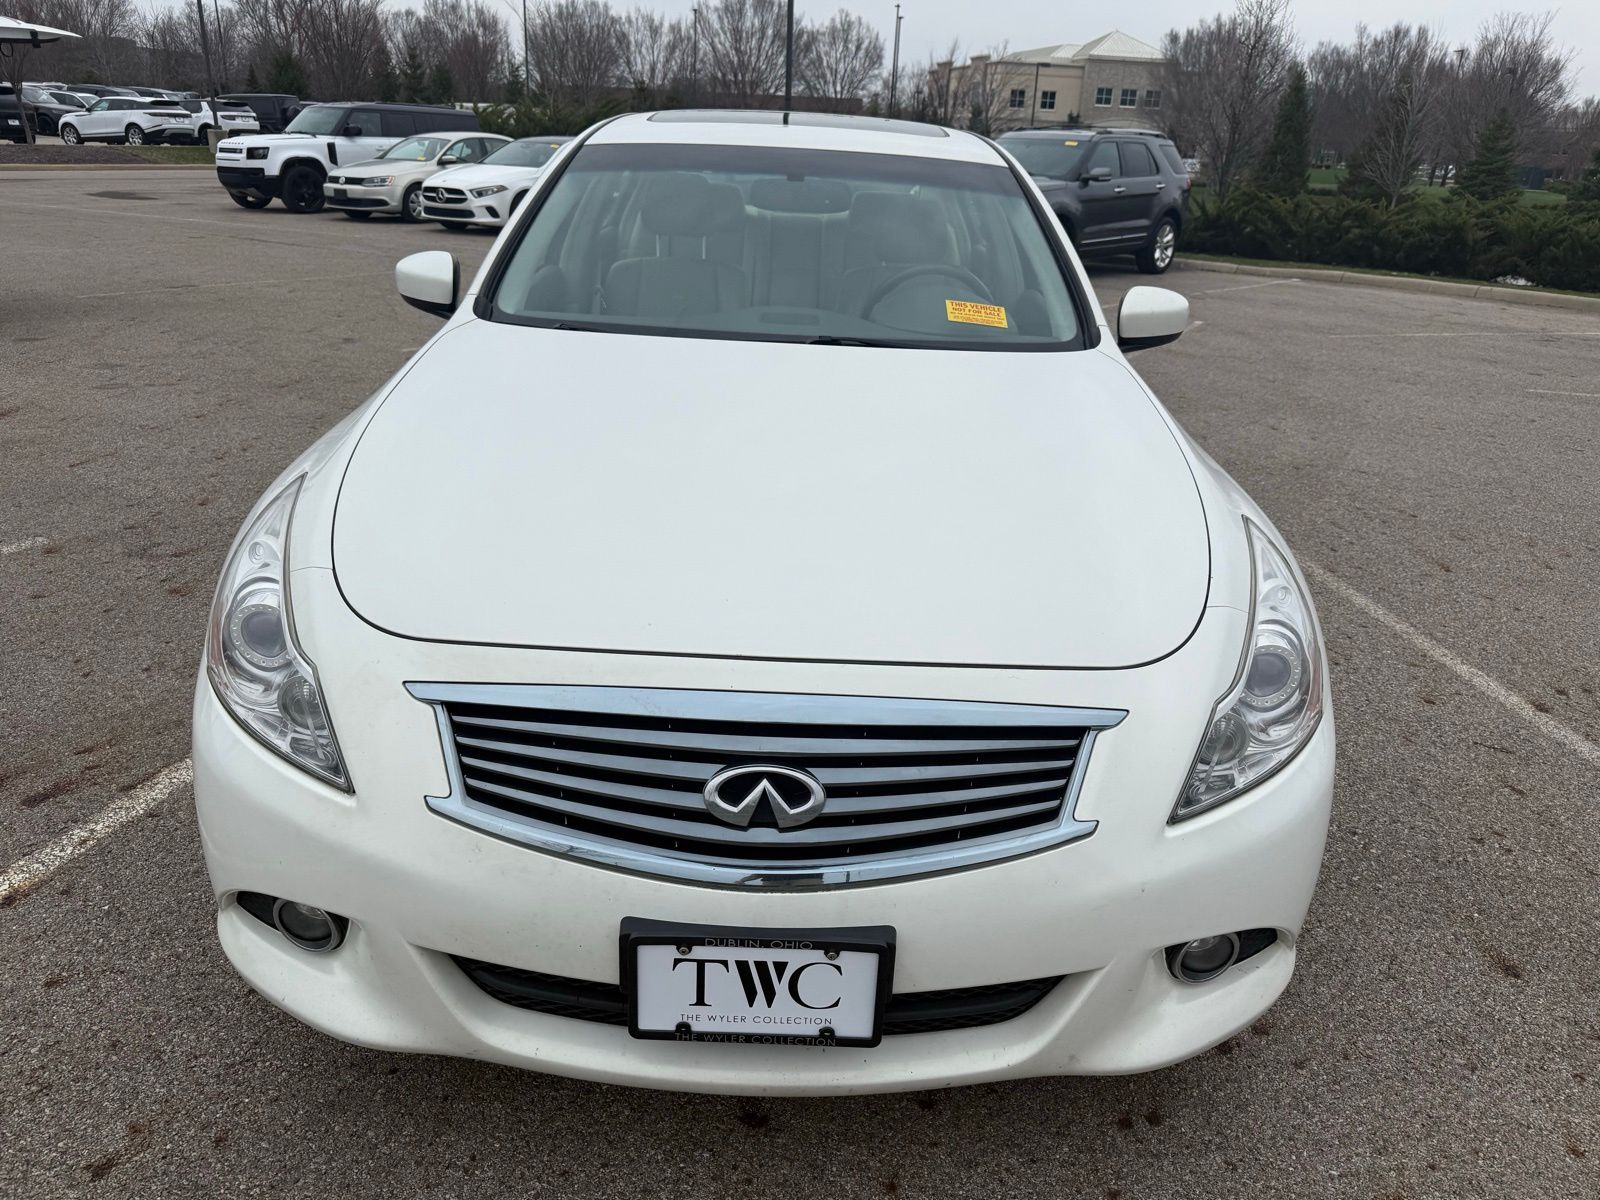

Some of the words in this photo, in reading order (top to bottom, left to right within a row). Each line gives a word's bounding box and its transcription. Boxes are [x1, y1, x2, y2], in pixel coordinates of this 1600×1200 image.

[970, 304, 1002, 313] VEHICLE
[770, 940, 813, 950] OHIO
[672, 957, 843, 1010] TWC
[680, 1013, 702, 1022] THE
[707, 1014, 747, 1024] WYLER
[752, 1015, 833, 1025] COLLECTION
[675, 1032, 698, 1042] THE
[703, 1033, 746, 1044] WYLER
[750, 1035, 837, 1047] COLLECTION
